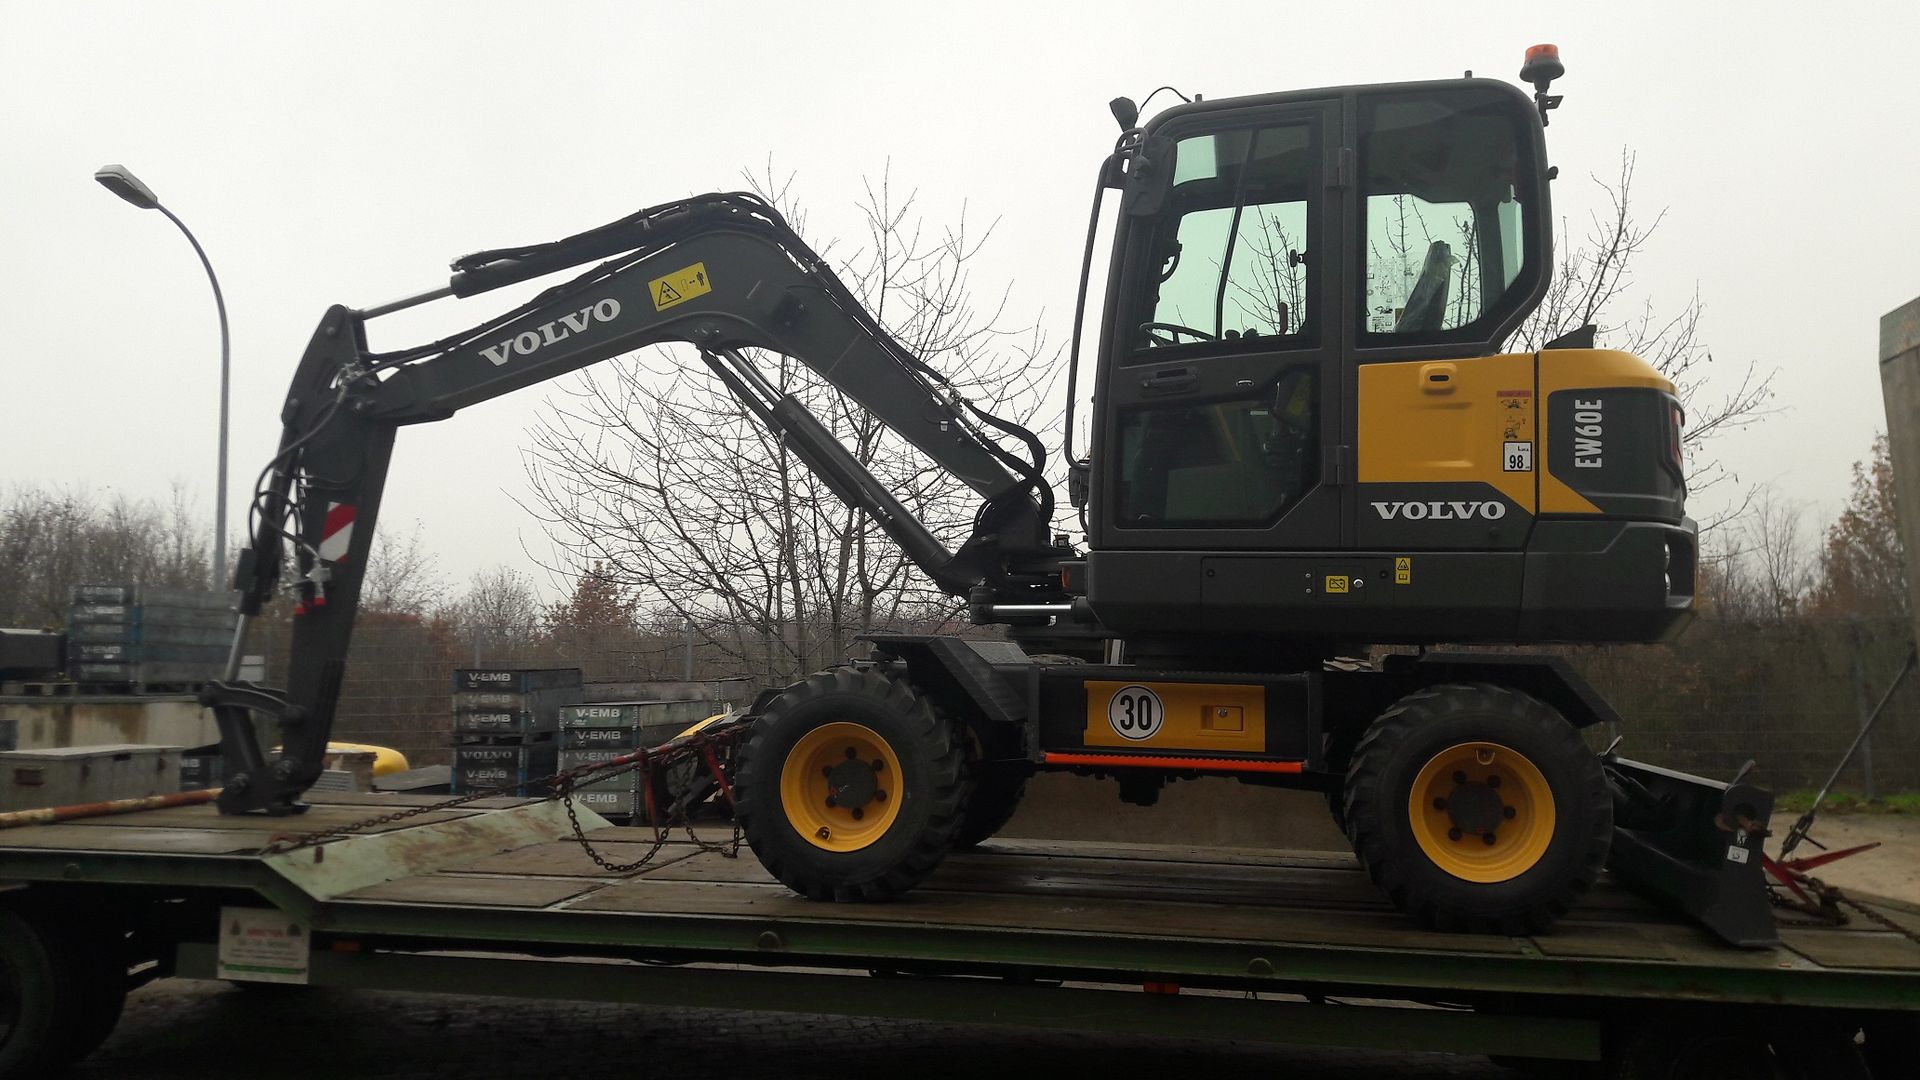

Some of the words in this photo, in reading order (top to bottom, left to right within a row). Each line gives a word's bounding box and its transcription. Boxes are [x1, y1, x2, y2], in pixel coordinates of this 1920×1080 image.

[478, 298, 621, 367] VOLVO
[1574, 399, 1602, 468] EW60E
[1509, 455, 1524, 469] 98
[1371, 501, 1506, 520] VOLVO
[81, 645, 121, 654] V-EMB
[468, 672, 511, 682] V-EMB
[575, 708, 621, 718] V-EMB
[1119, 694, 1152, 731] 30
[468, 713, 511, 723] V-EMB
[577, 730, 621, 740] V-EMB
[462, 750, 513, 760] VOLVO
[466, 769, 507, 779] V-EMB
[573, 793, 618, 803] V-EMB
